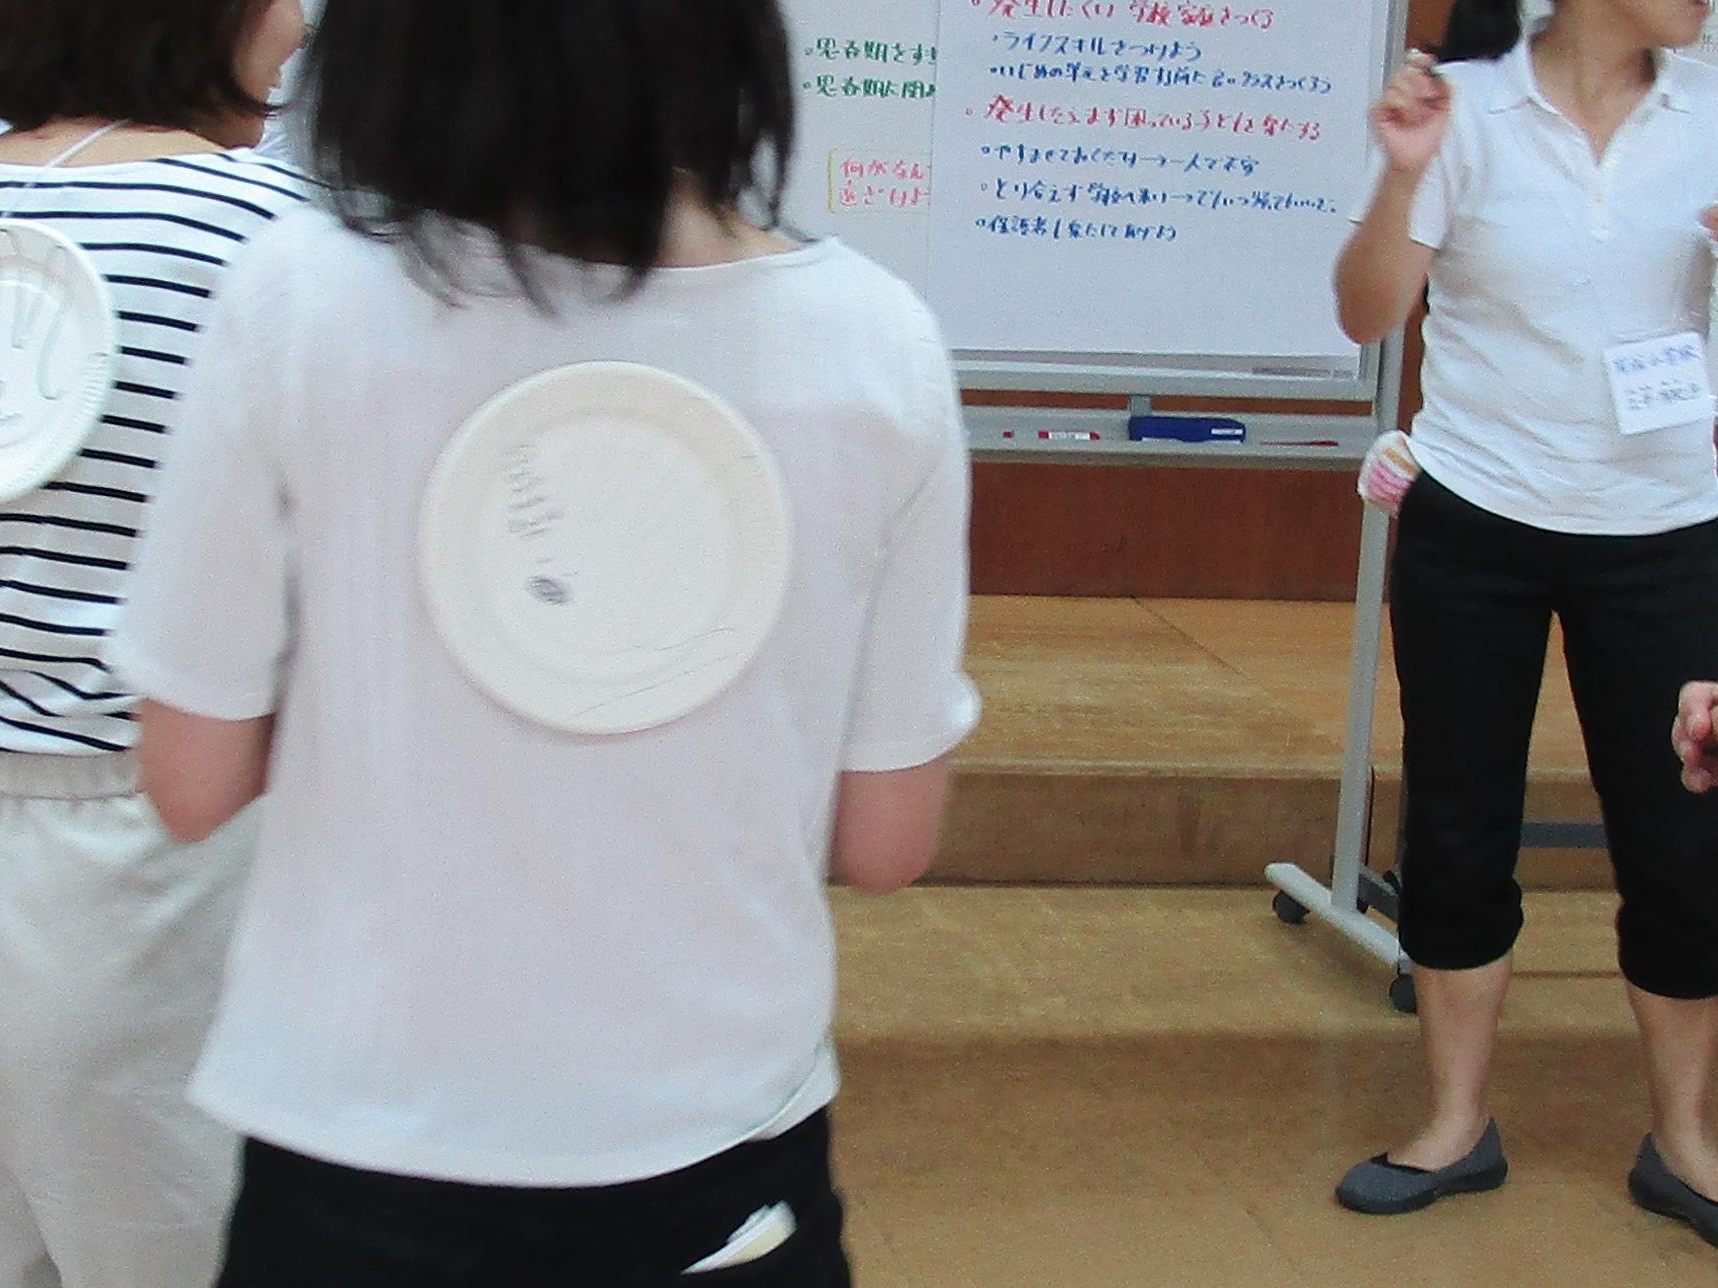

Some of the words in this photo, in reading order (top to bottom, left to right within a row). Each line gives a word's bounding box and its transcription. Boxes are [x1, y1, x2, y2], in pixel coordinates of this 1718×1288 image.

[1002, 31, 1203, 62] ライフスキルをつけよう
